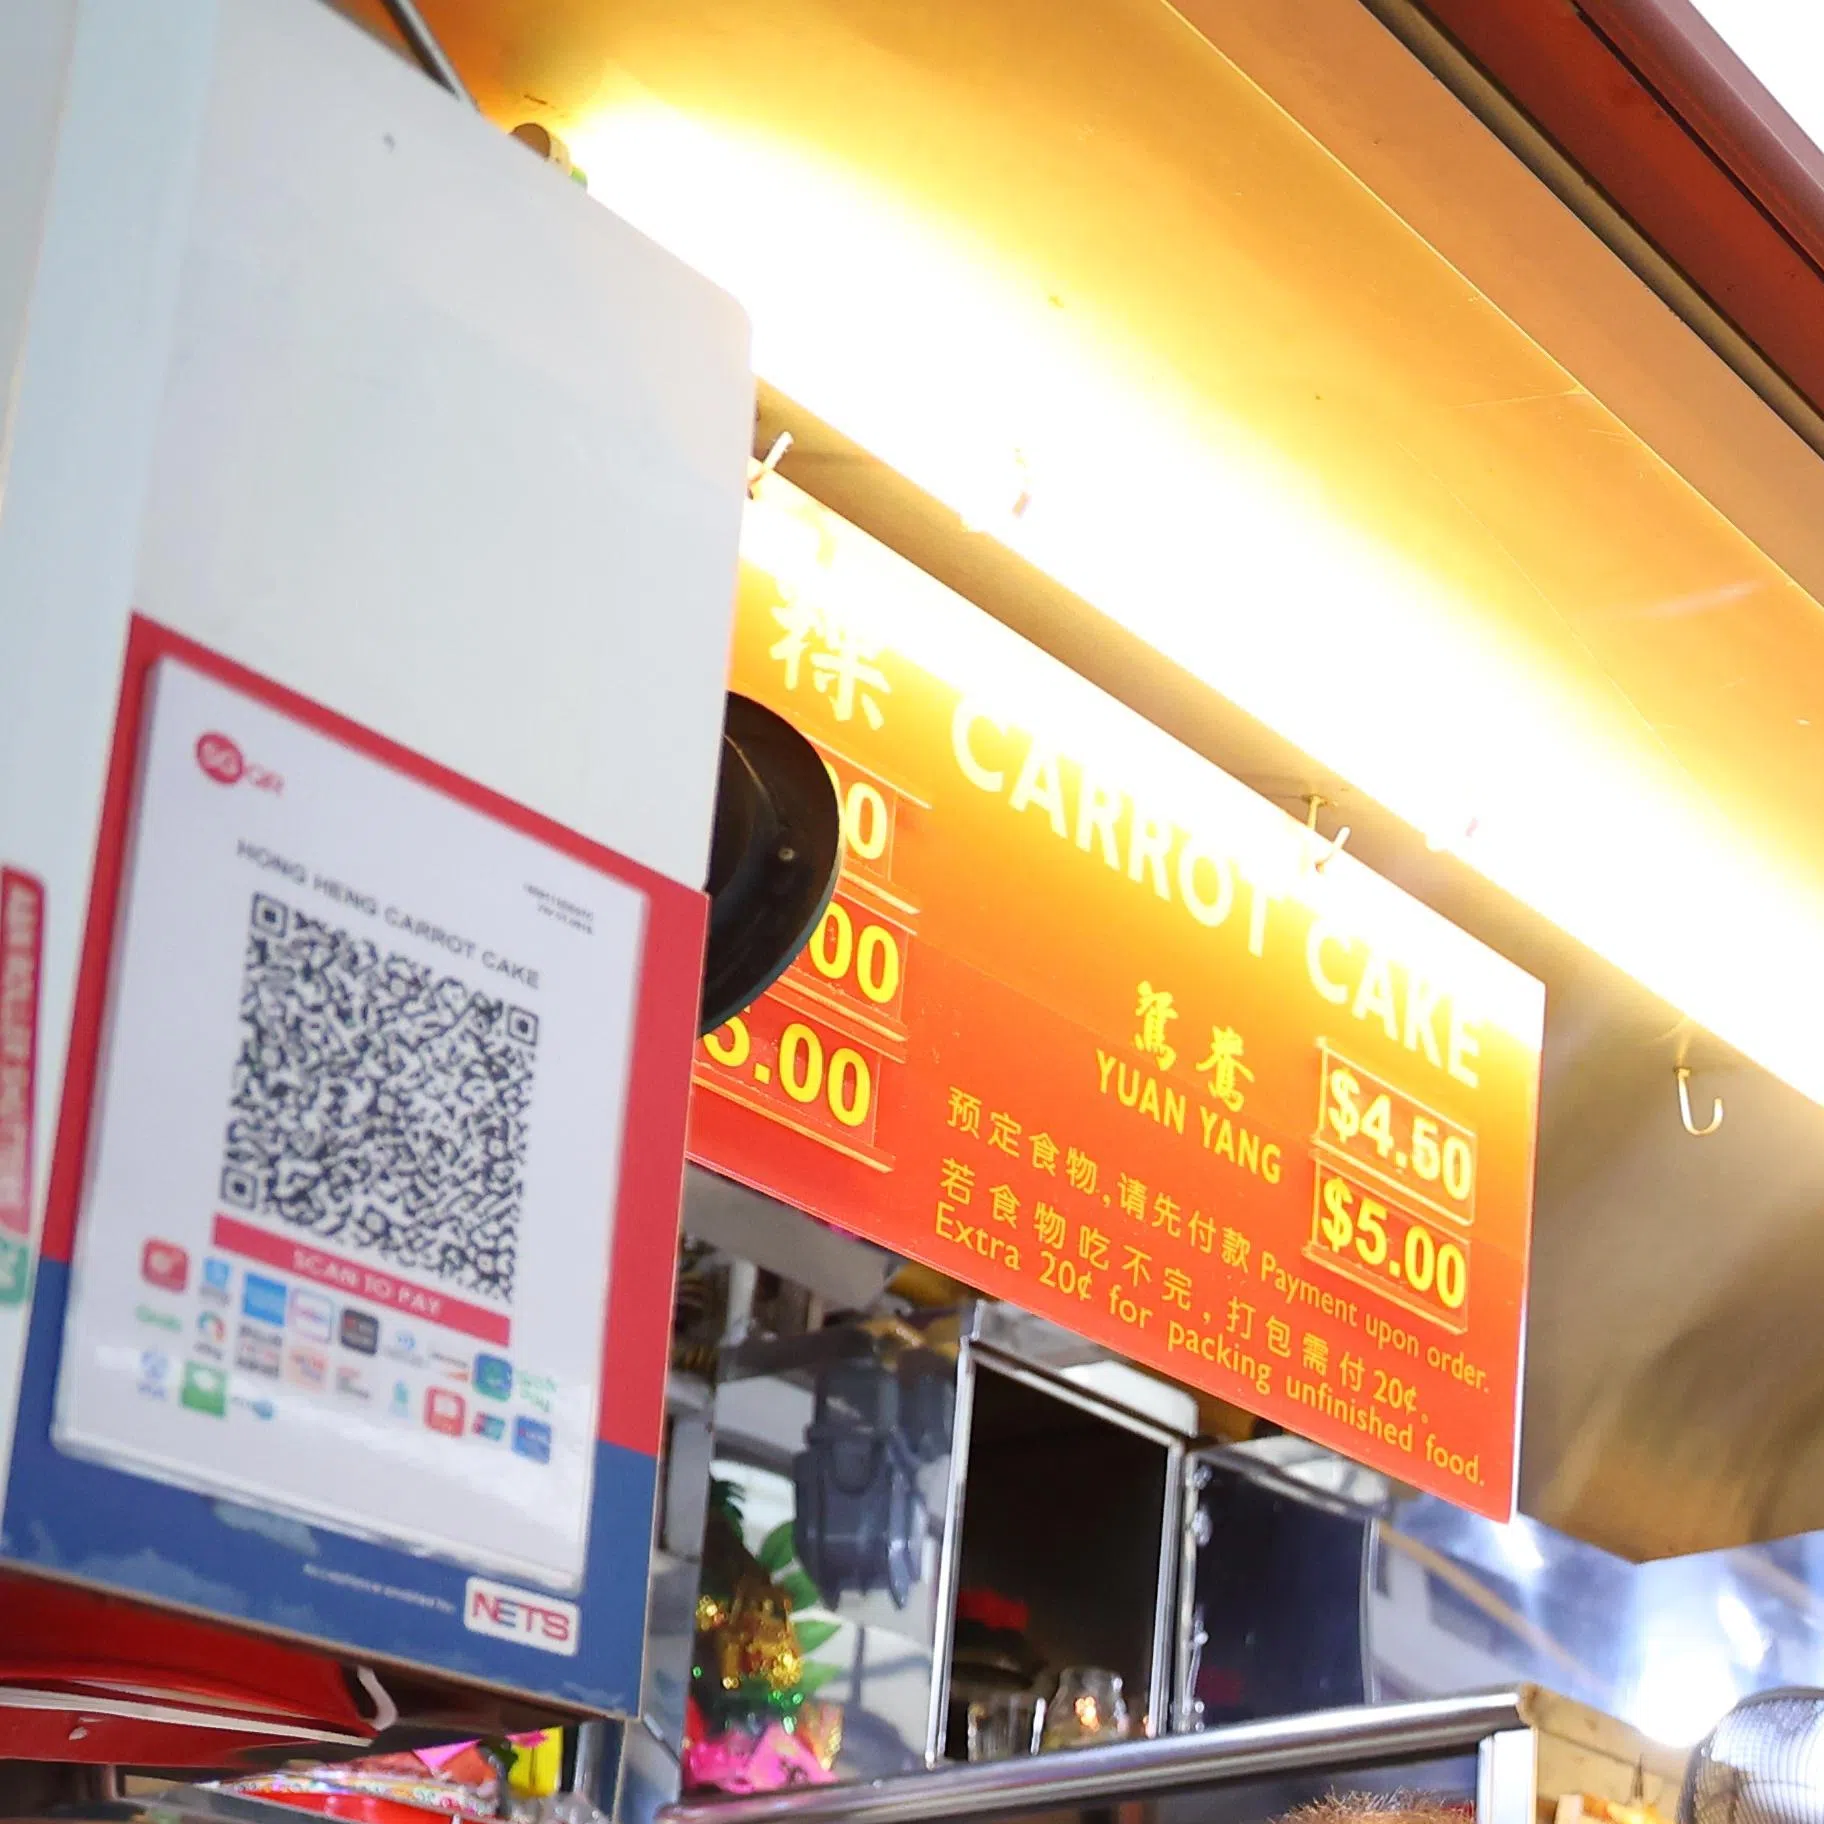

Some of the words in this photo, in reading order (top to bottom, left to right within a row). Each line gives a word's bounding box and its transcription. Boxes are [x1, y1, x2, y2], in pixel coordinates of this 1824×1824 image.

[236, 839, 306, 885] HONG
[312, 873, 378, 917] HENG
[384, 905, 478, 960] CARROT
[481, 950, 541, 991] CAKE
[951, 698, 1295, 957] CARROT
[1303, 908, 1481, 1088] CAKE
[1096, 1048, 1187, 1136] YUAN
[1199, 1104, 1283, 1186] YANG
[293, 1248, 360, 1287] SCAN
[363, 1273, 393, 1298] TO
[398, 1286, 441, 1315] PAY
[1321, 1176, 1467, 1309] $5.00
[935, 1200, 1022, 1272] Extra
[1039, 1250, 1094, 1302] 20¢
[1108, 1284, 1153, 1330] for
[1167, 1319, 1273, 1397] packing
[1285, 1372, 1414, 1454] unfinished
[1424, 1434, 1488, 1488] food.
[1260, 1249, 1359, 1328] Payment
[1364, 1311, 1419, 1359] upon
[1426, 1338, 1491, 1394] order.
[471, 1590, 571, 1643] NETS
